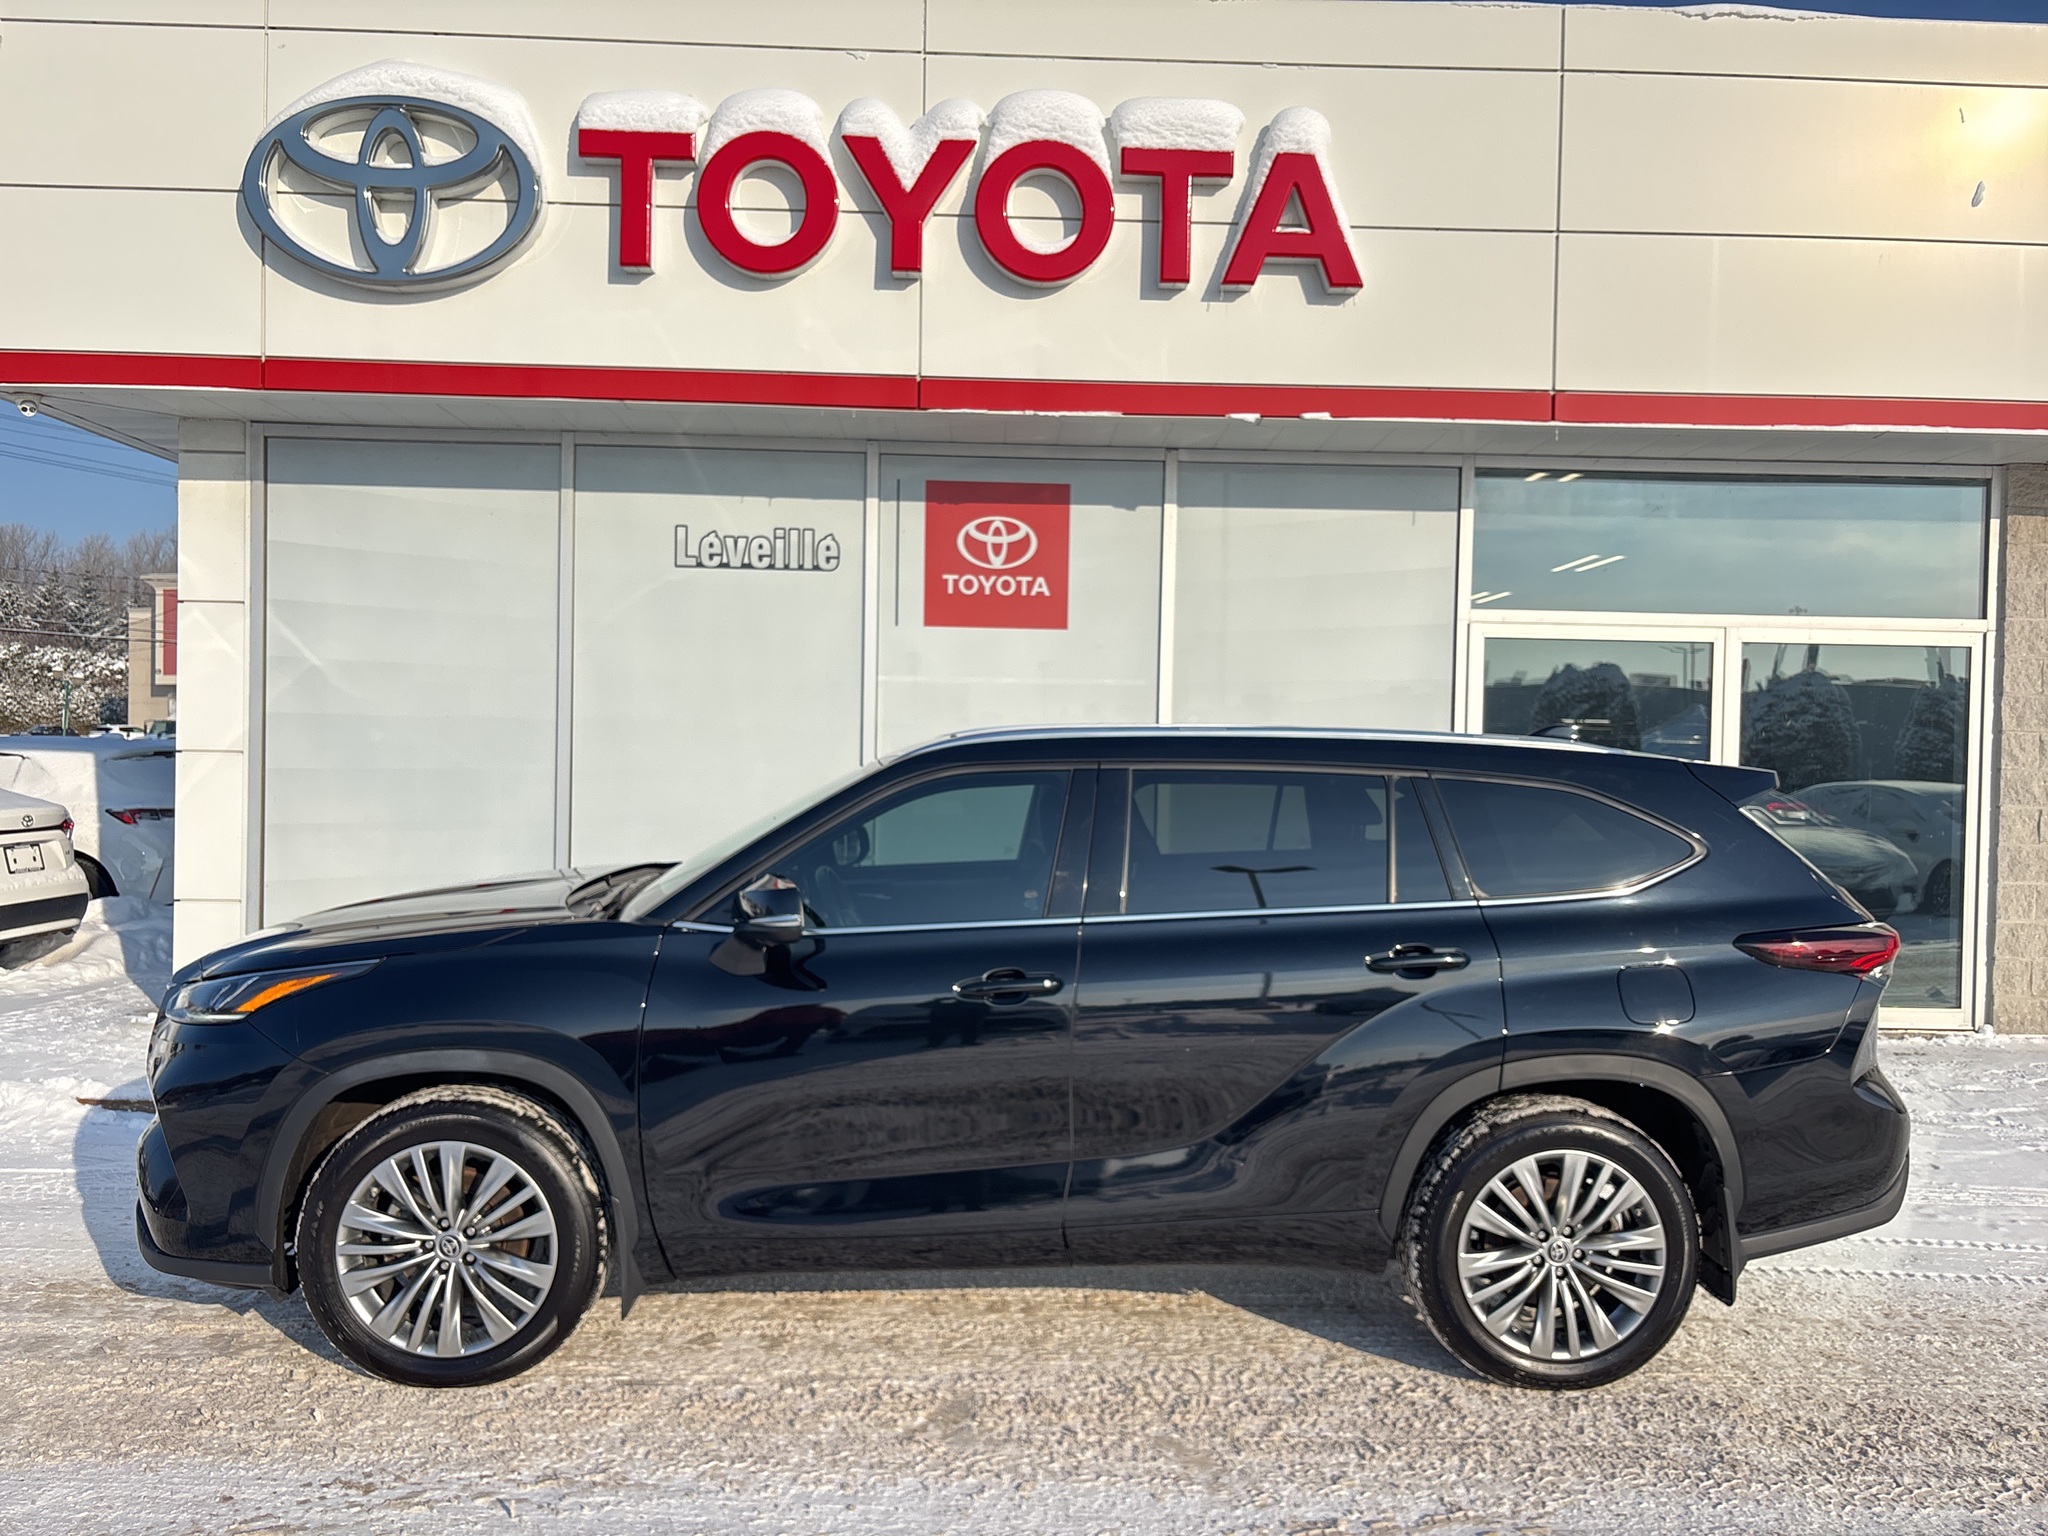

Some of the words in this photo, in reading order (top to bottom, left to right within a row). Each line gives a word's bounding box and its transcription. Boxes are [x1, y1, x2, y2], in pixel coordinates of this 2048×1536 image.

[578, 128, 1364, 293] TOYOTA
[675, 525, 841, 572] Léveillé
[941, 574, 1051, 597] TOYOTA
